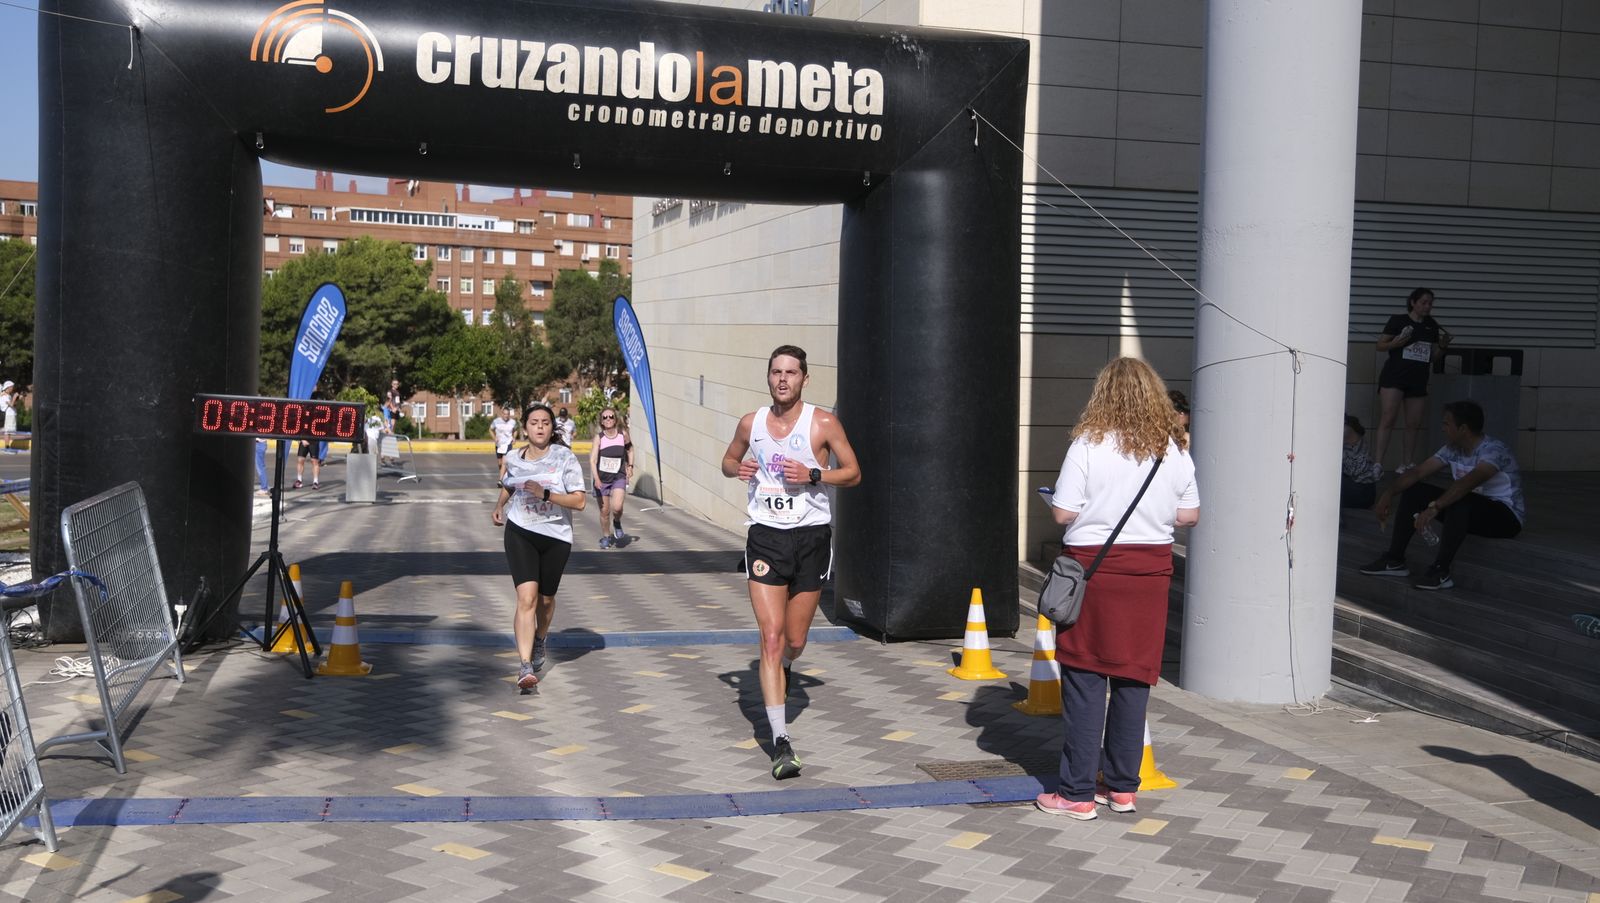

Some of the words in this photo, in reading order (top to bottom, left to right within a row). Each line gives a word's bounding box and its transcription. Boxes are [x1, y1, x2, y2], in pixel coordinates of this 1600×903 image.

[567, 102, 752, 134] cronometraje
[758, 113, 883, 142] deportivo
[764, 496, 794, 510] 161
